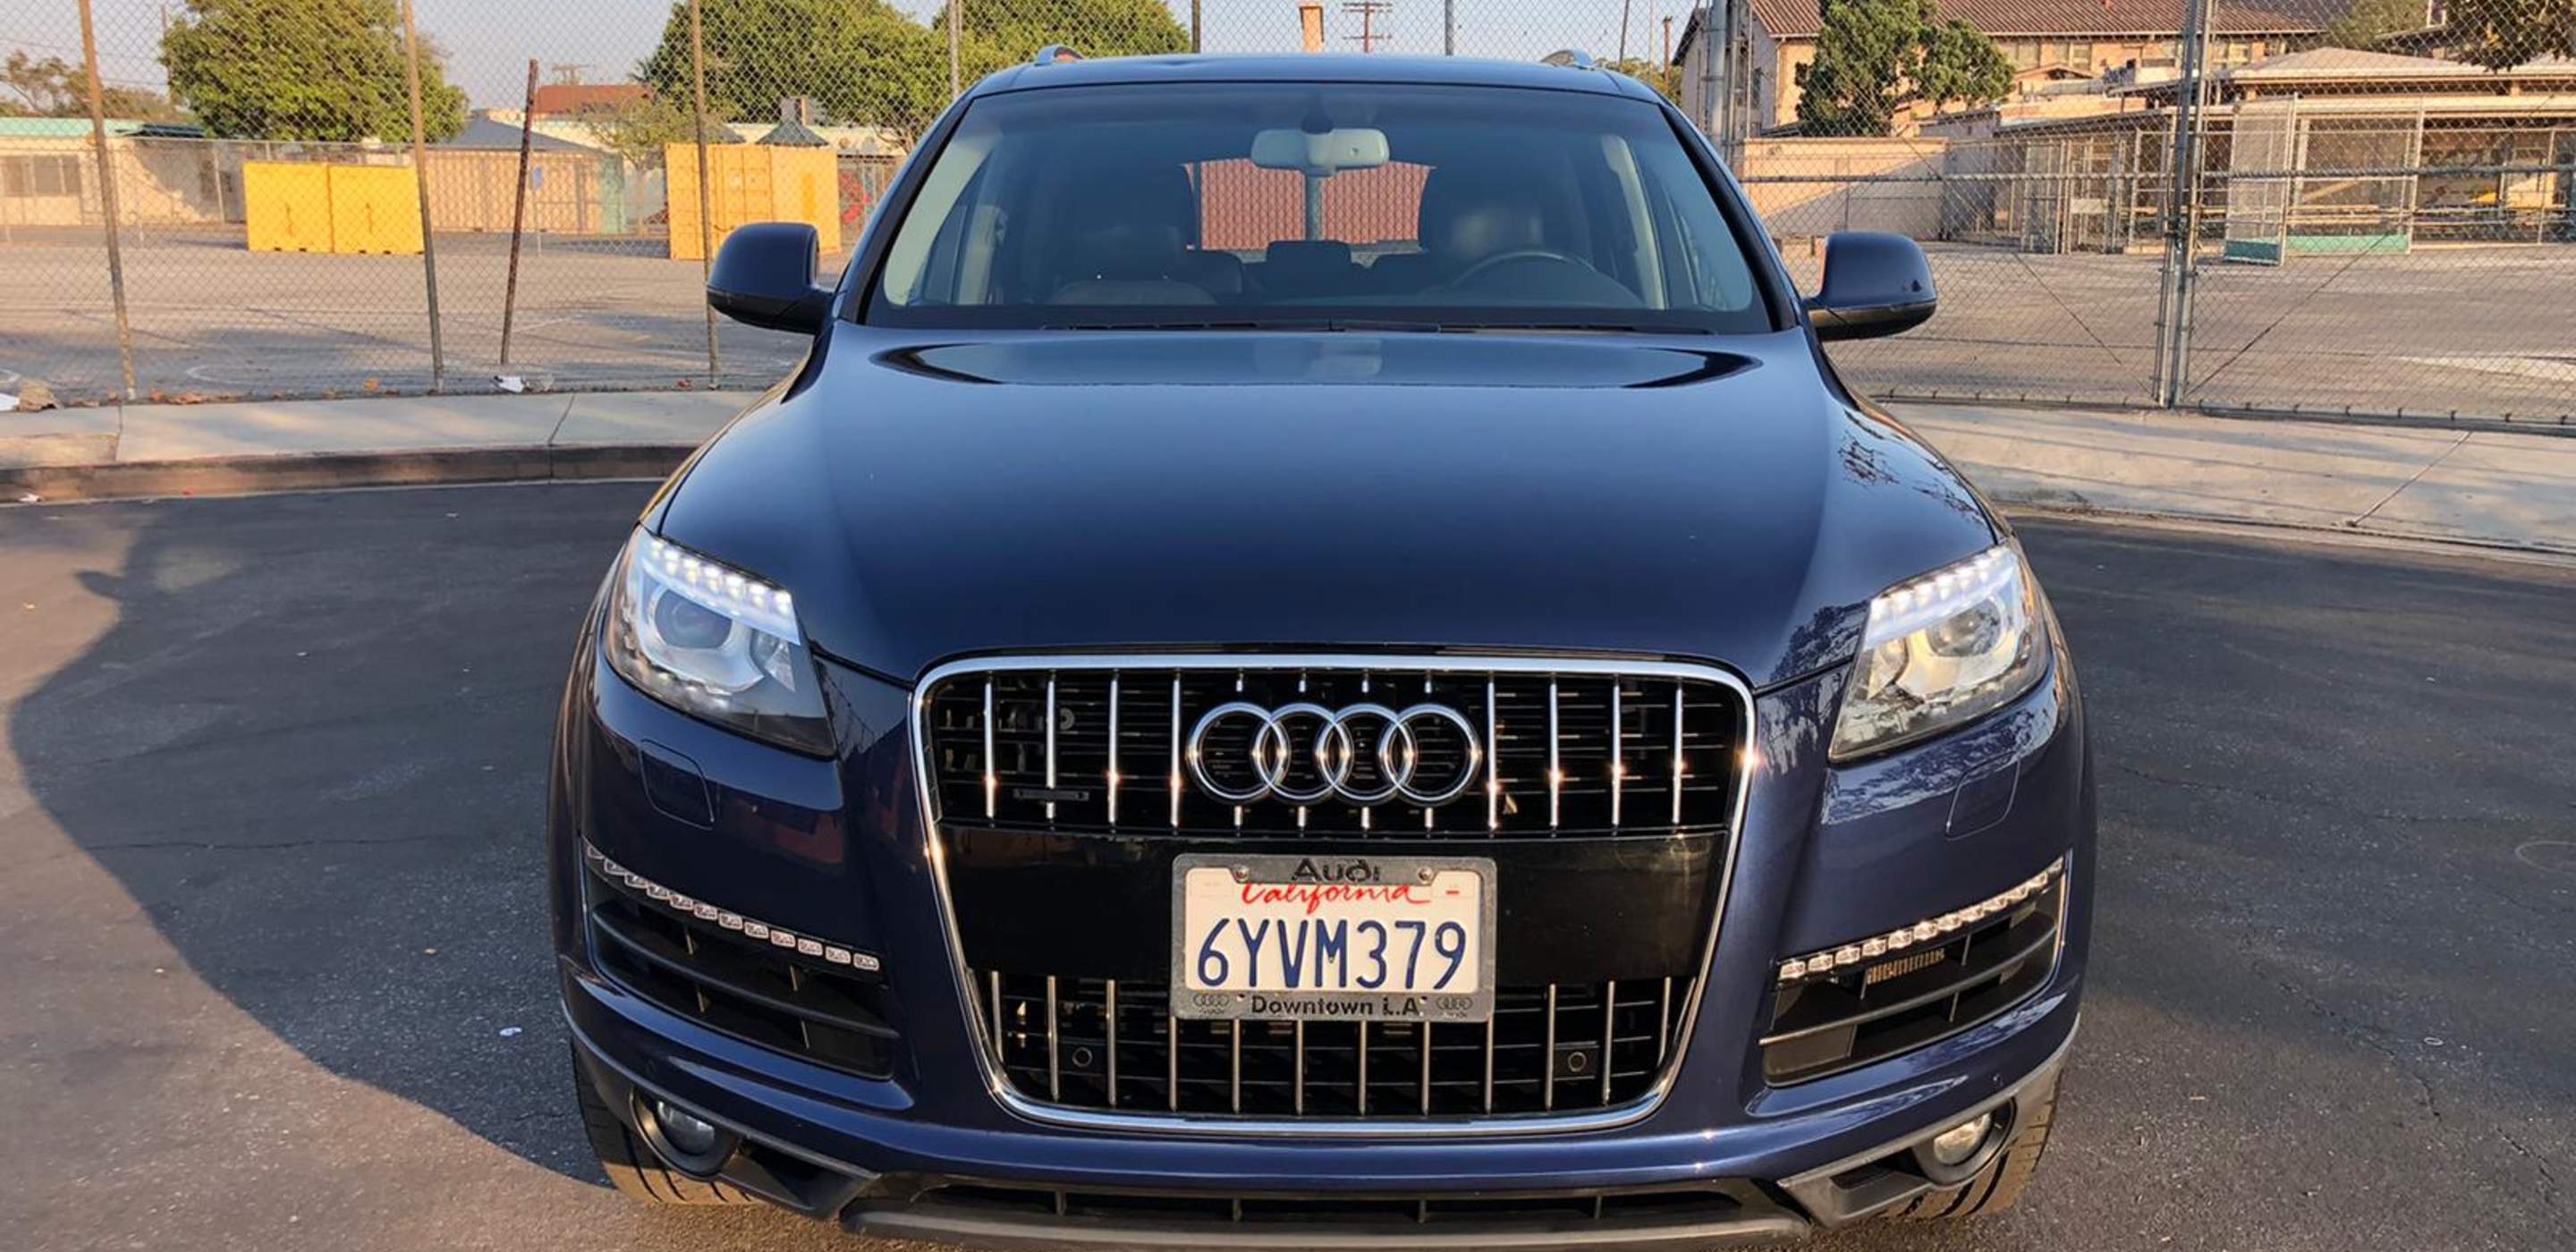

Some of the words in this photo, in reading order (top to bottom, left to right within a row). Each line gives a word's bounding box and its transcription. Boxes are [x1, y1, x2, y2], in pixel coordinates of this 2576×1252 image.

[1291, 858, 1380, 883] Audi
[1241, 882, 1431, 915] California
[1198, 918, 1466, 990] 6YVM379
[1252, 995, 1373, 1016] Downtown
